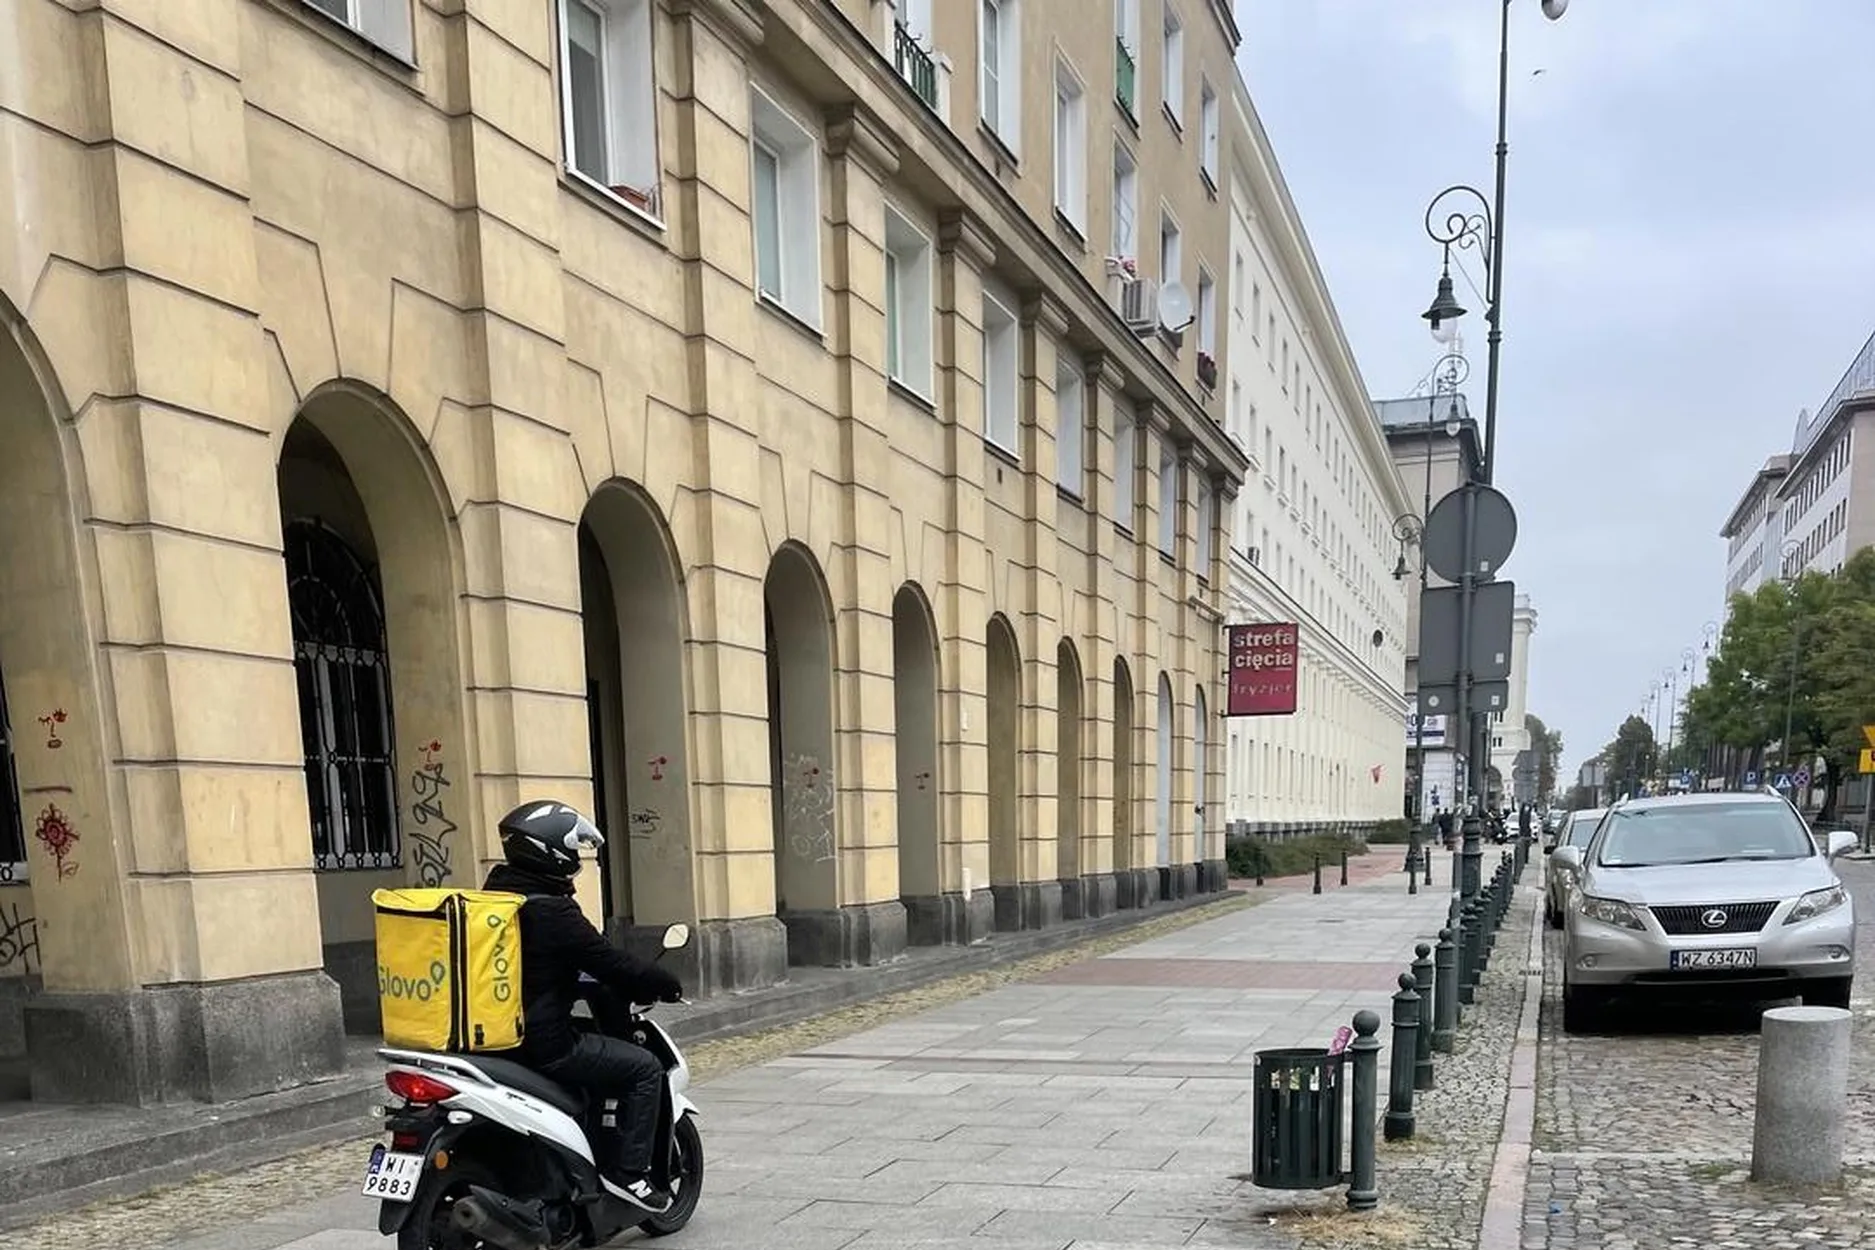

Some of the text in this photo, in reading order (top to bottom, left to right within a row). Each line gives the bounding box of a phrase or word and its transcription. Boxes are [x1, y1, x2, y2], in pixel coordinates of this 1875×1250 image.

[1233, 629, 1295, 647] strefa
[1235, 648, 1294, 670] cięcia
[493, 926, 511, 1002] Glov
[1682, 951, 1753, 966] WZ 6347N
[385, 1156, 405, 1173] WI
[367, 1176, 411, 1196] 9883
